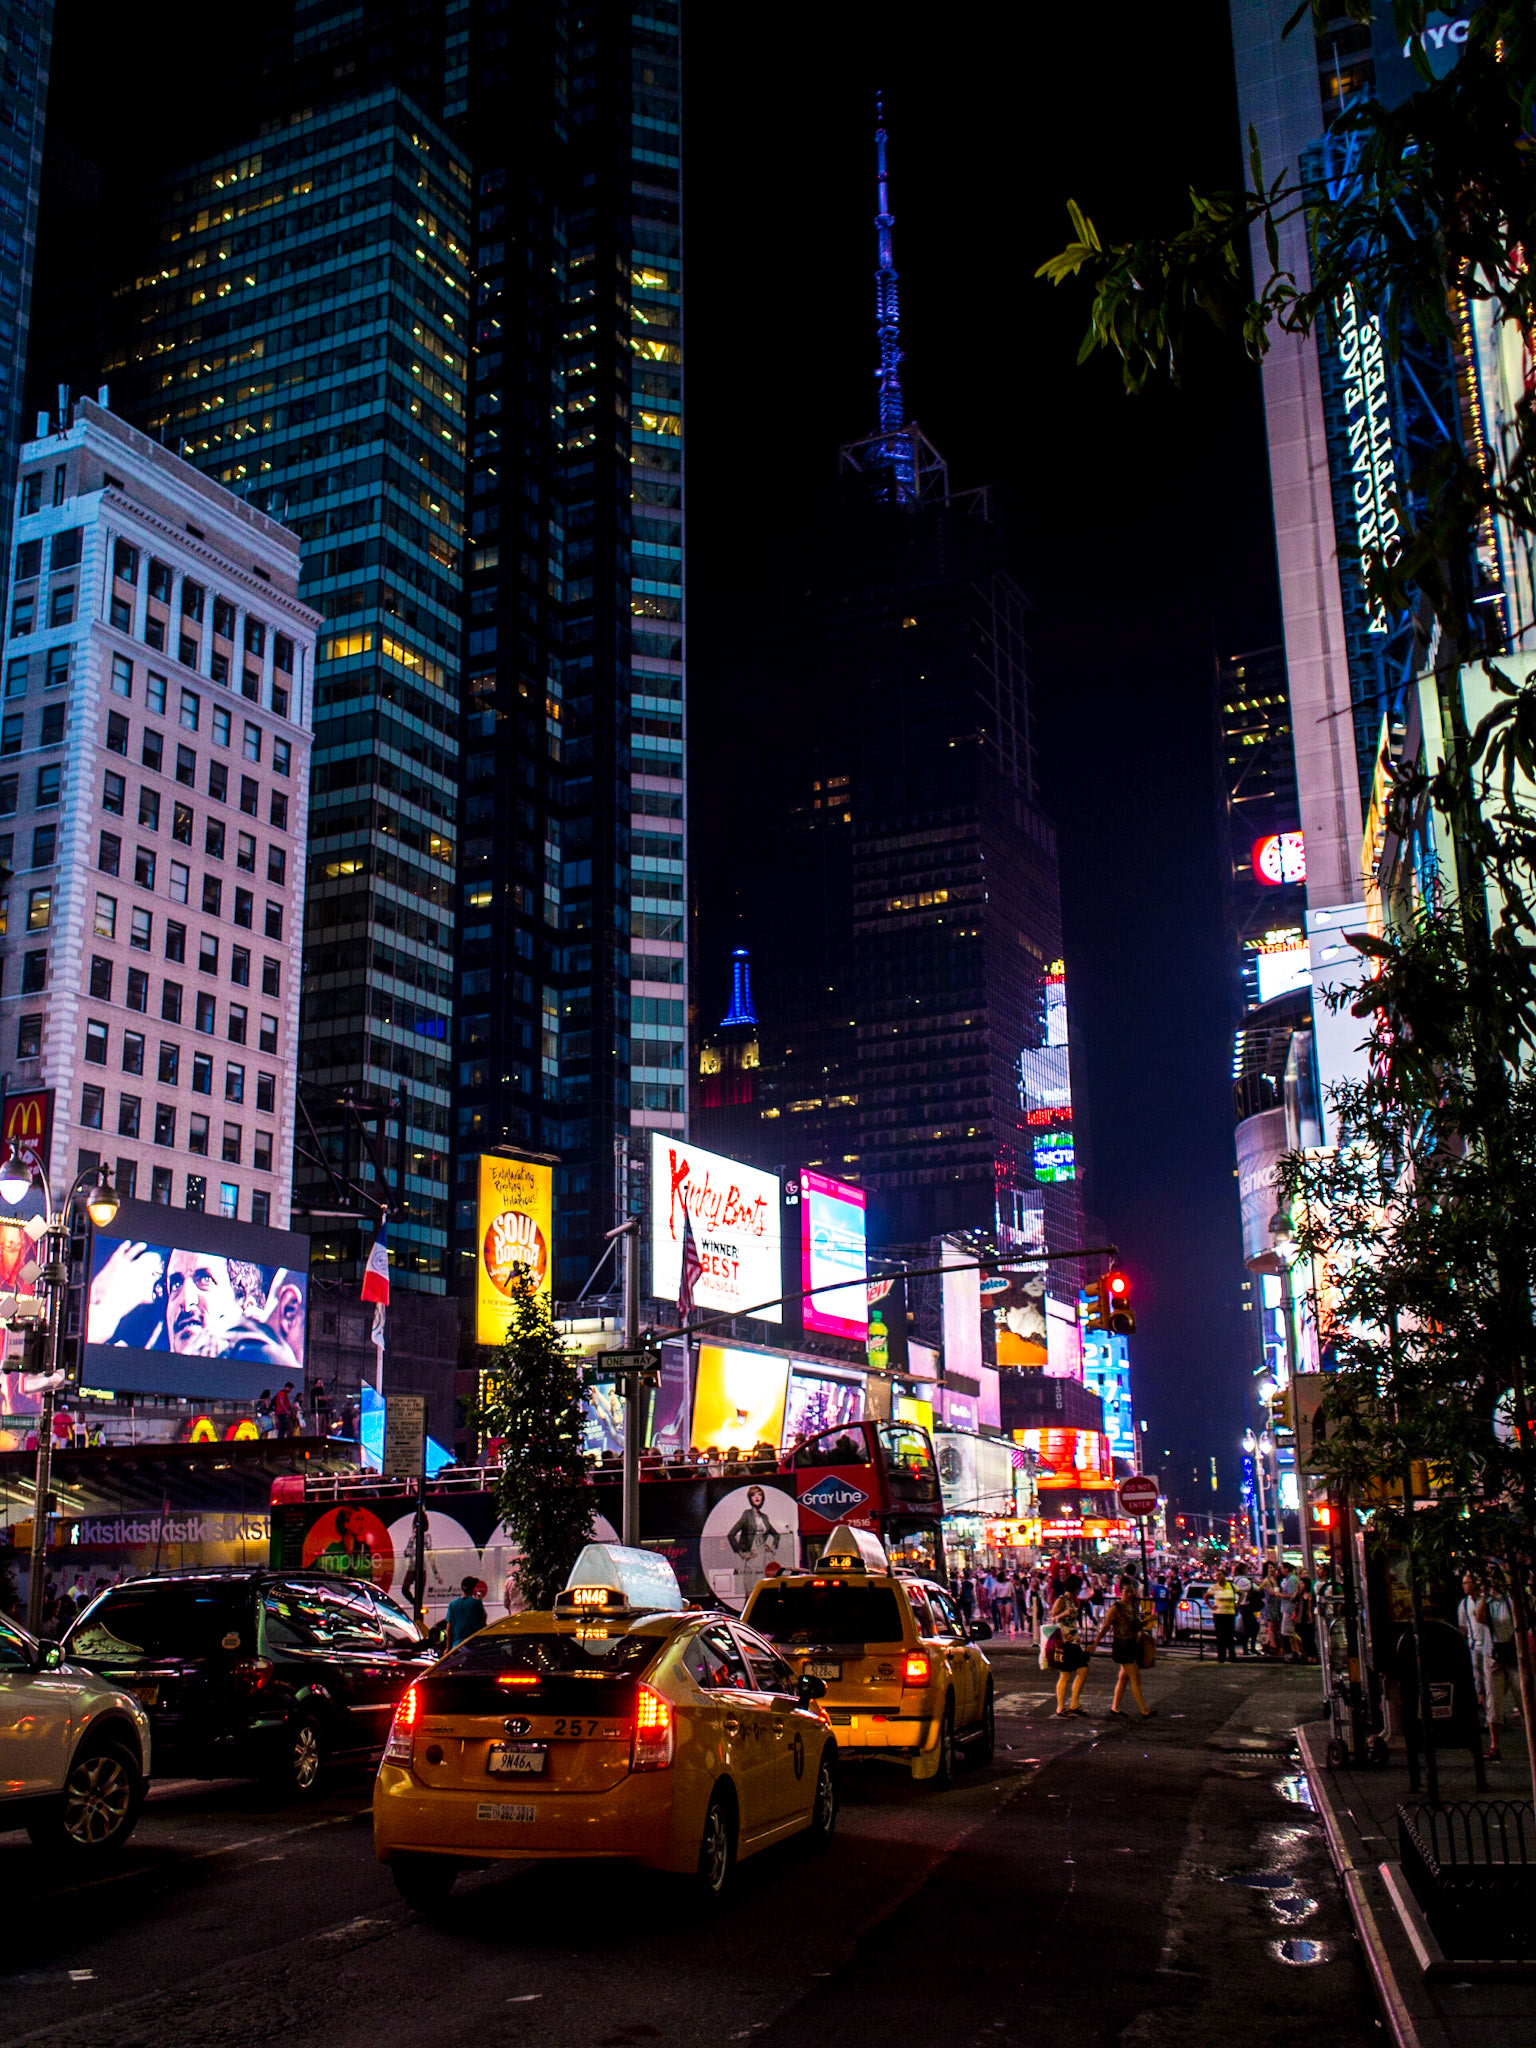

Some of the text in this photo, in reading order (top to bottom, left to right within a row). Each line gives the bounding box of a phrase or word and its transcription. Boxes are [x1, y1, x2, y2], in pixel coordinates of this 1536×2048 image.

[1259, 939, 1310, 955] TOSHIBA
[668, 1148, 768, 1241] Kinky Boots
[492, 1212, 538, 1249] SOUL
[494, 1243, 540, 1268] DOCTOR
[701, 1253, 740, 1280] BEST
[701, 1276, 740, 1295] MUSICAL
[979, 1280, 1008, 1291] ostess
[606, 1355, 651, 1367] ONE WAY
[1137, 1483, 1151, 1491] NOT
[1128, 1501, 1151, 1509] ENTER
[321, 1545, 383, 1570] impulse
[554, 1719, 599, 1737] 257
